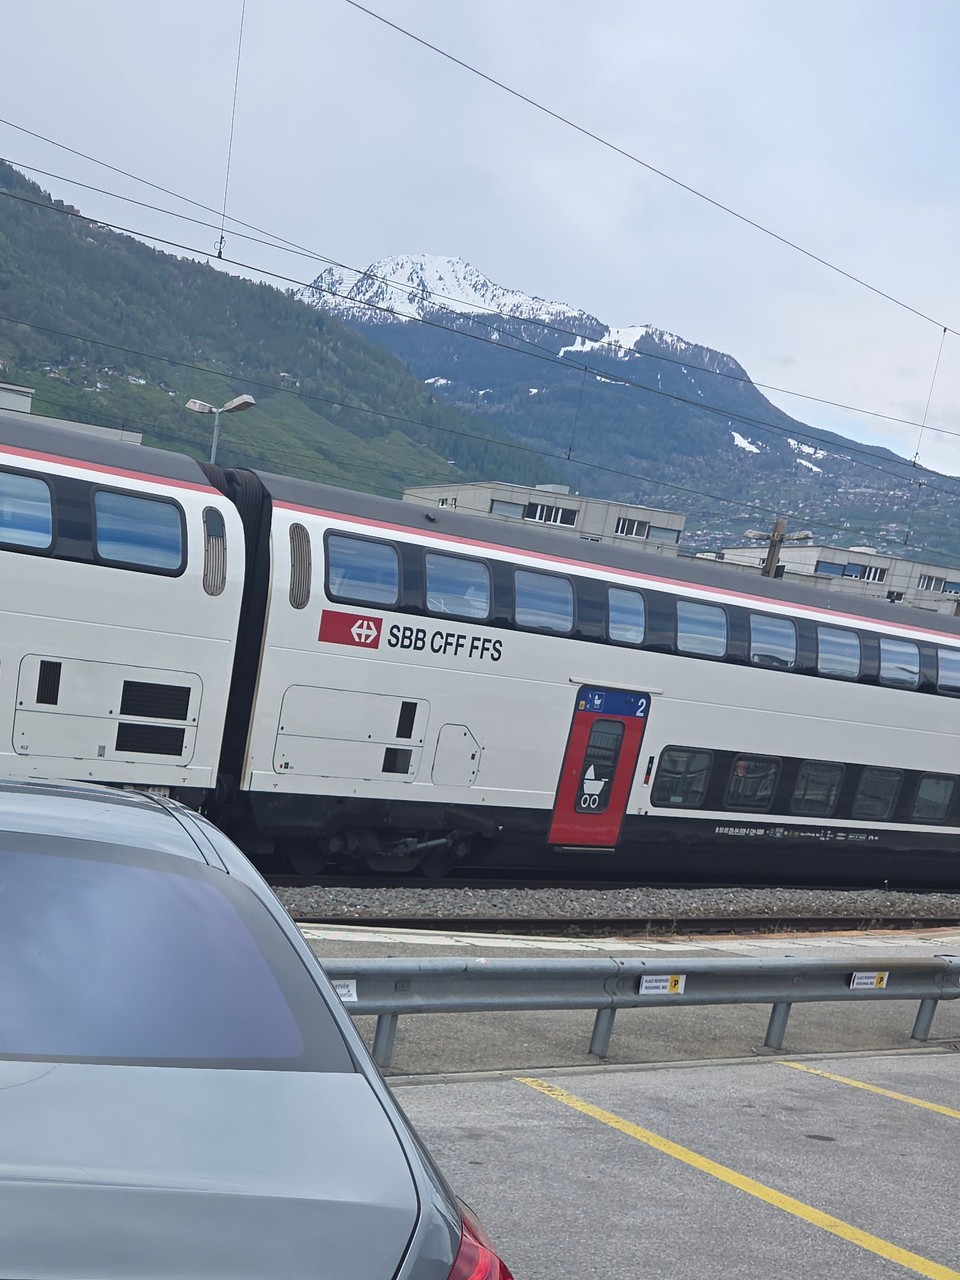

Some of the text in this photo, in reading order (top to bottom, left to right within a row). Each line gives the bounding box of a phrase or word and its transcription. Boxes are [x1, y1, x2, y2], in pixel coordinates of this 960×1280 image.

[387, 624, 503, 662] SBB CFF FFS
[635, 698, 647, 717] 2
